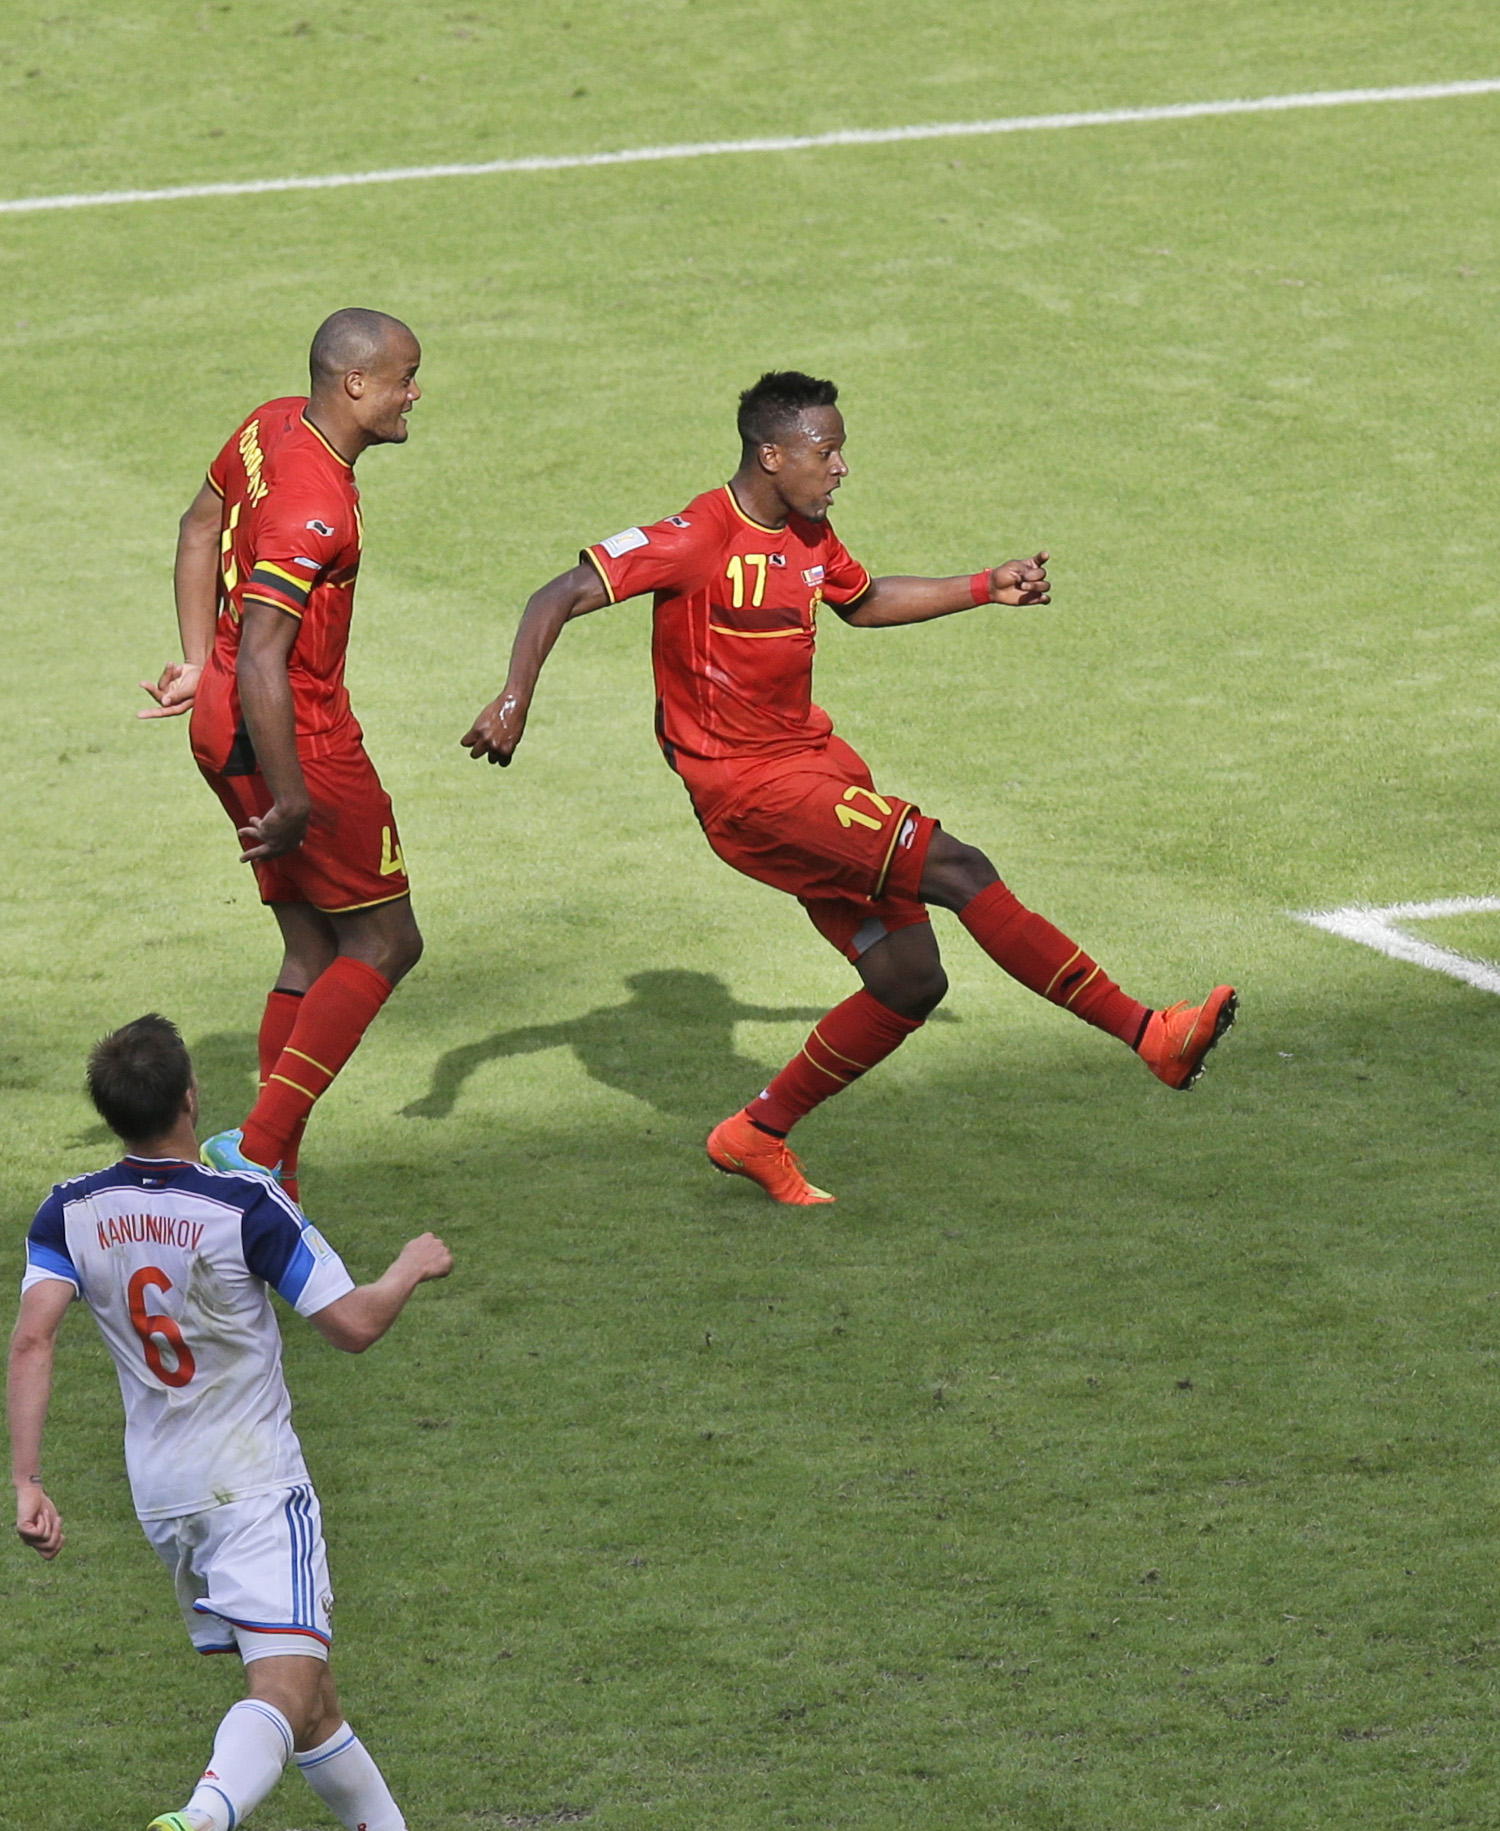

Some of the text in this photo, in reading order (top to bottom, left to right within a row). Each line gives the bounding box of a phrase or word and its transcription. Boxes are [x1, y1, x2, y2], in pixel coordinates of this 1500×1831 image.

[725, 553, 769, 608] 17
[833, 785, 893, 831] 17
[380, 825, 406, 877] 4
[127, 1265, 196, 1388] 6
